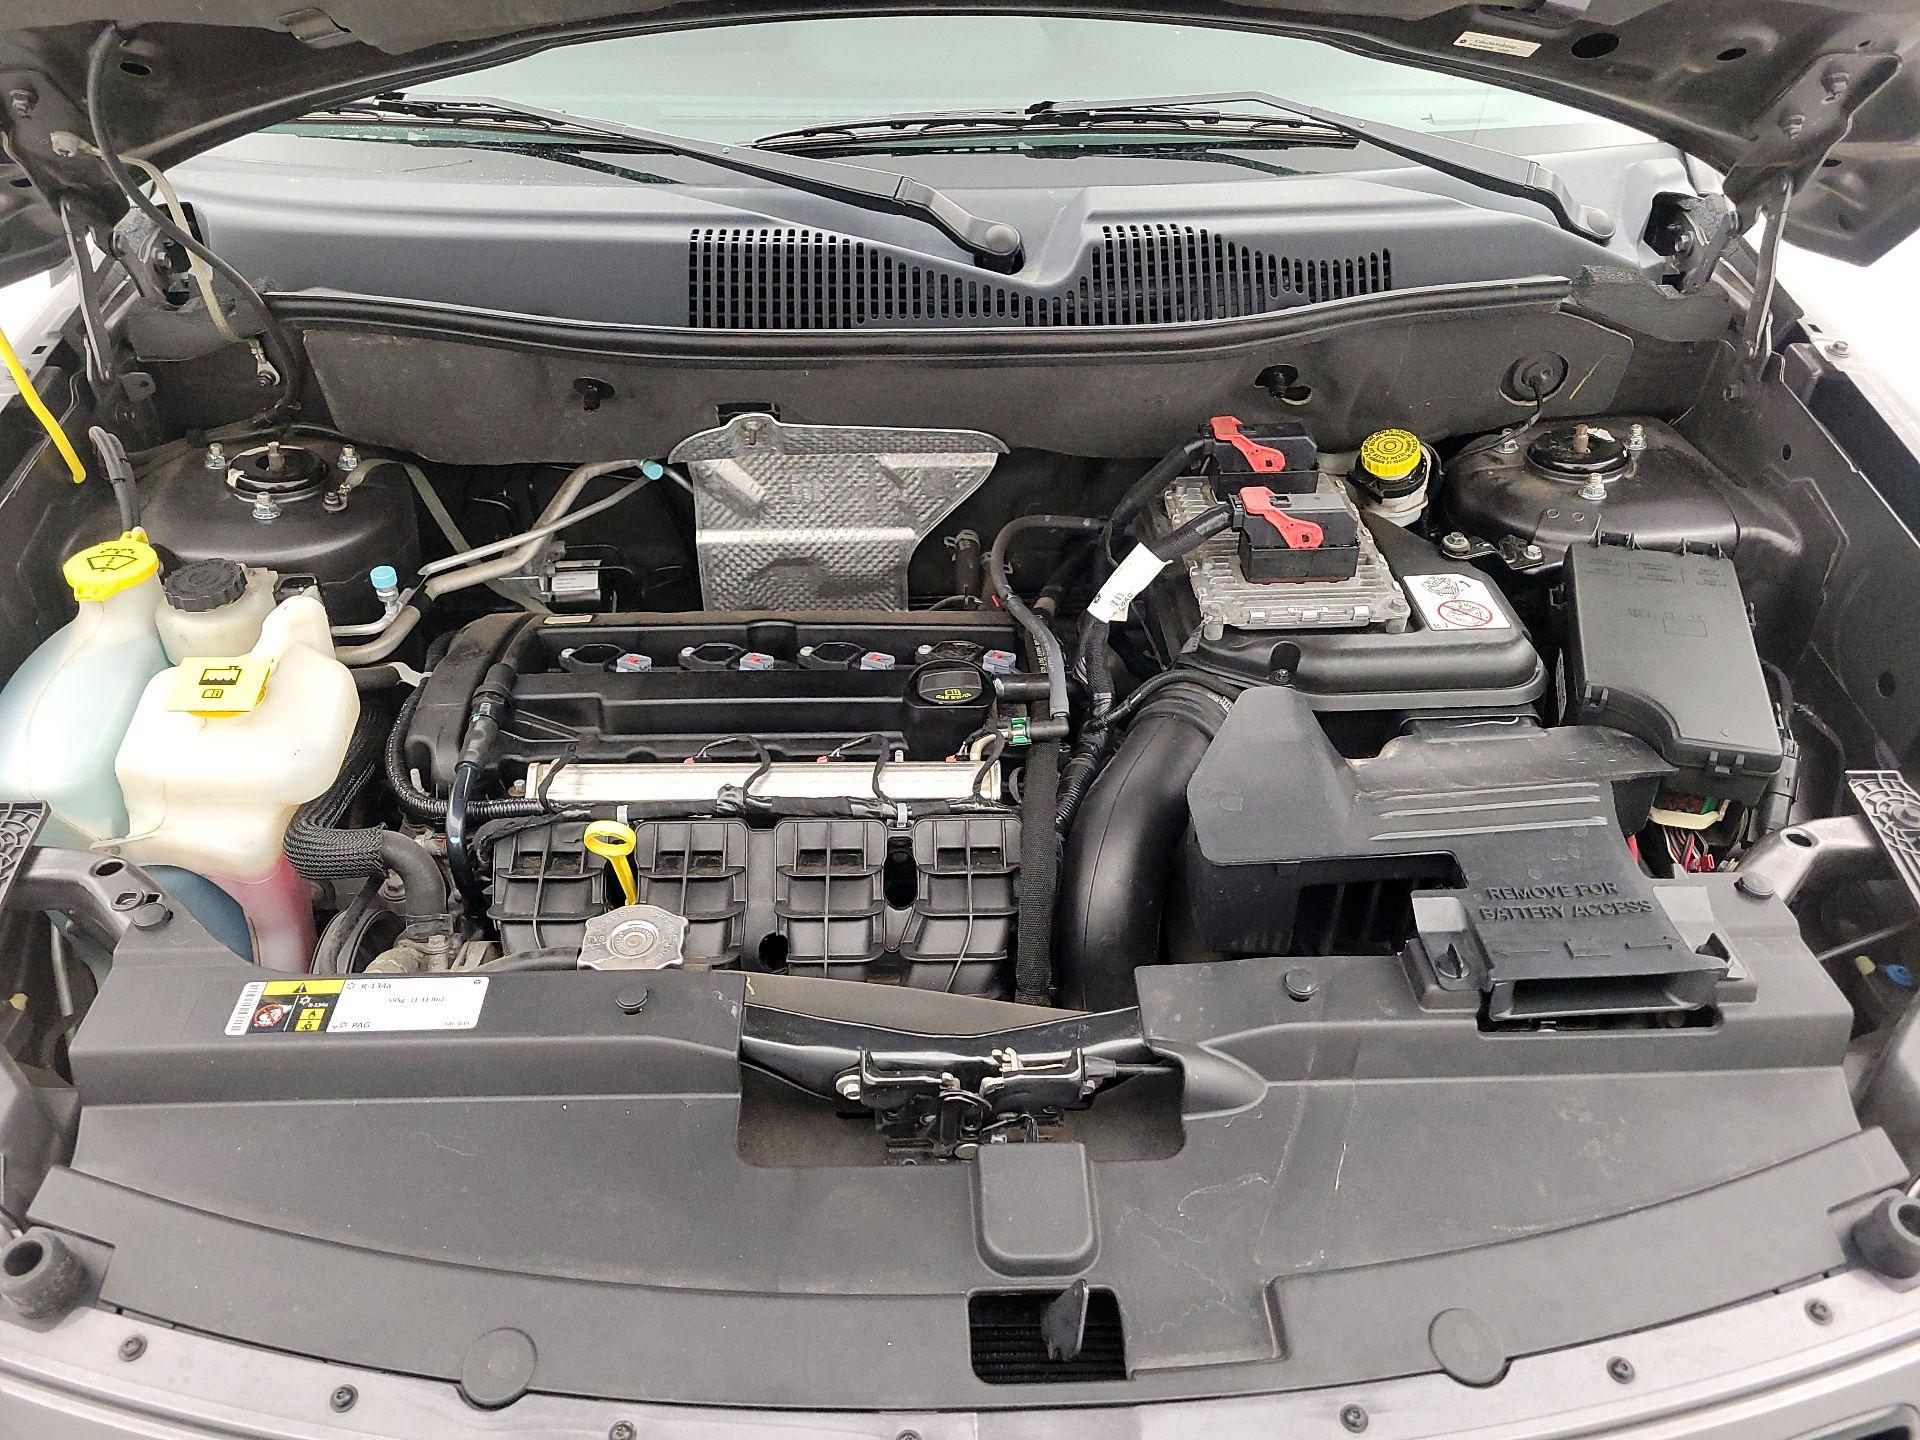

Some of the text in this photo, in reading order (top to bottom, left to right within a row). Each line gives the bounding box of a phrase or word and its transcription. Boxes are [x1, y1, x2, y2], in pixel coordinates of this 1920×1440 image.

[1486, 881, 1618, 900] REMOVE FOR
[1479, 900, 1653, 921] BATTERY ACCESS
[360, 982, 392, 990] R-134a
[351, 1021, 371, 1029] PAG
